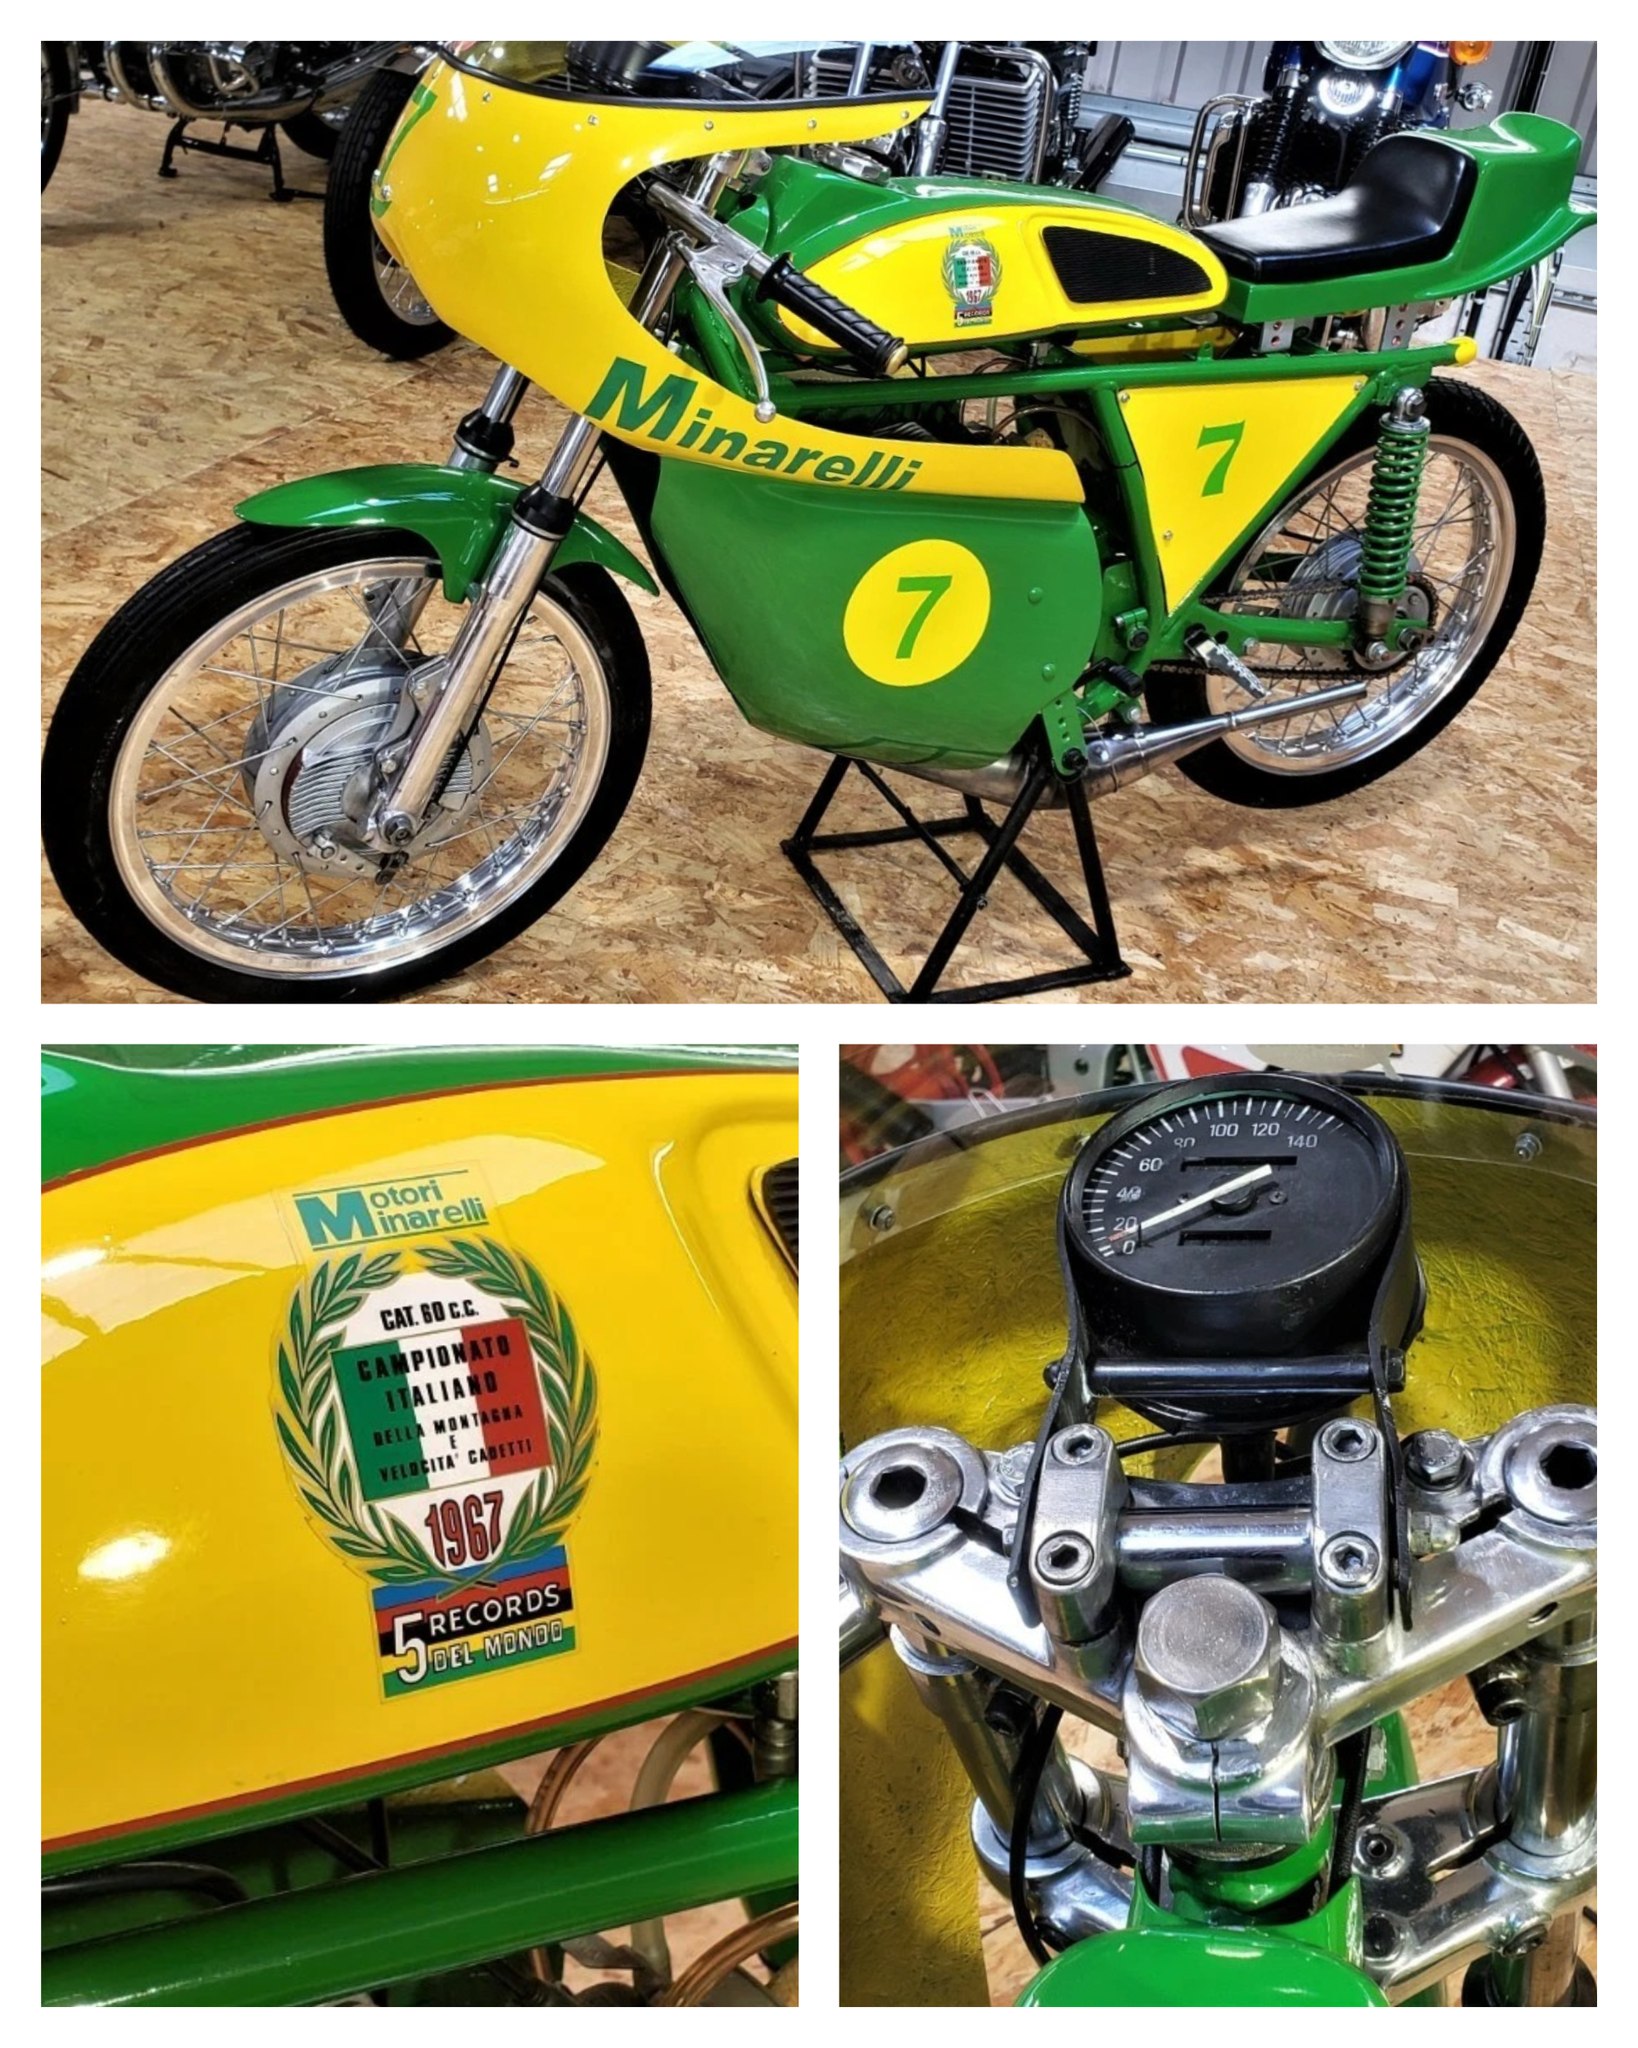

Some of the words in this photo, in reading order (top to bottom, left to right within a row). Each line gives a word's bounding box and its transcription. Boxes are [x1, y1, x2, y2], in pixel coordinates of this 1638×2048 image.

[584, 357, 922, 490] Minarelli
[1197, 421, 1245, 497] 7
[895, 575, 953, 660] 7
[1209, 1123, 1239, 1137] 100
[1251, 1122, 1280, 1137] 120
[1287, 1134, 1318, 1148] 140
[1138, 1158, 1163, 1172] 60
[1113, 1216, 1138, 1231] 20
[1122, 1240, 1136, 1255] 0
[380, 1305, 420, 1331] CAT.
[420, 1301, 446, 1324] 60
[357, 1335, 511, 1382] CAMPIONATO
[385, 1371, 498, 1412] ITALIANO
[373, 1423, 425, 1447] DELLA
[433, 1404, 524, 1435] MONTAGNA
[450, 1434, 457, 1449] E
[468, 1438, 532, 1465] CADETTI
[424, 1490, 505, 1569] 1967
[392, 1612, 427, 1684] 5
[429, 1583, 560, 1637] RECORDS
[432, 1642, 474, 1673] DEL
[483, 1621, 564, 1661] MONDO
